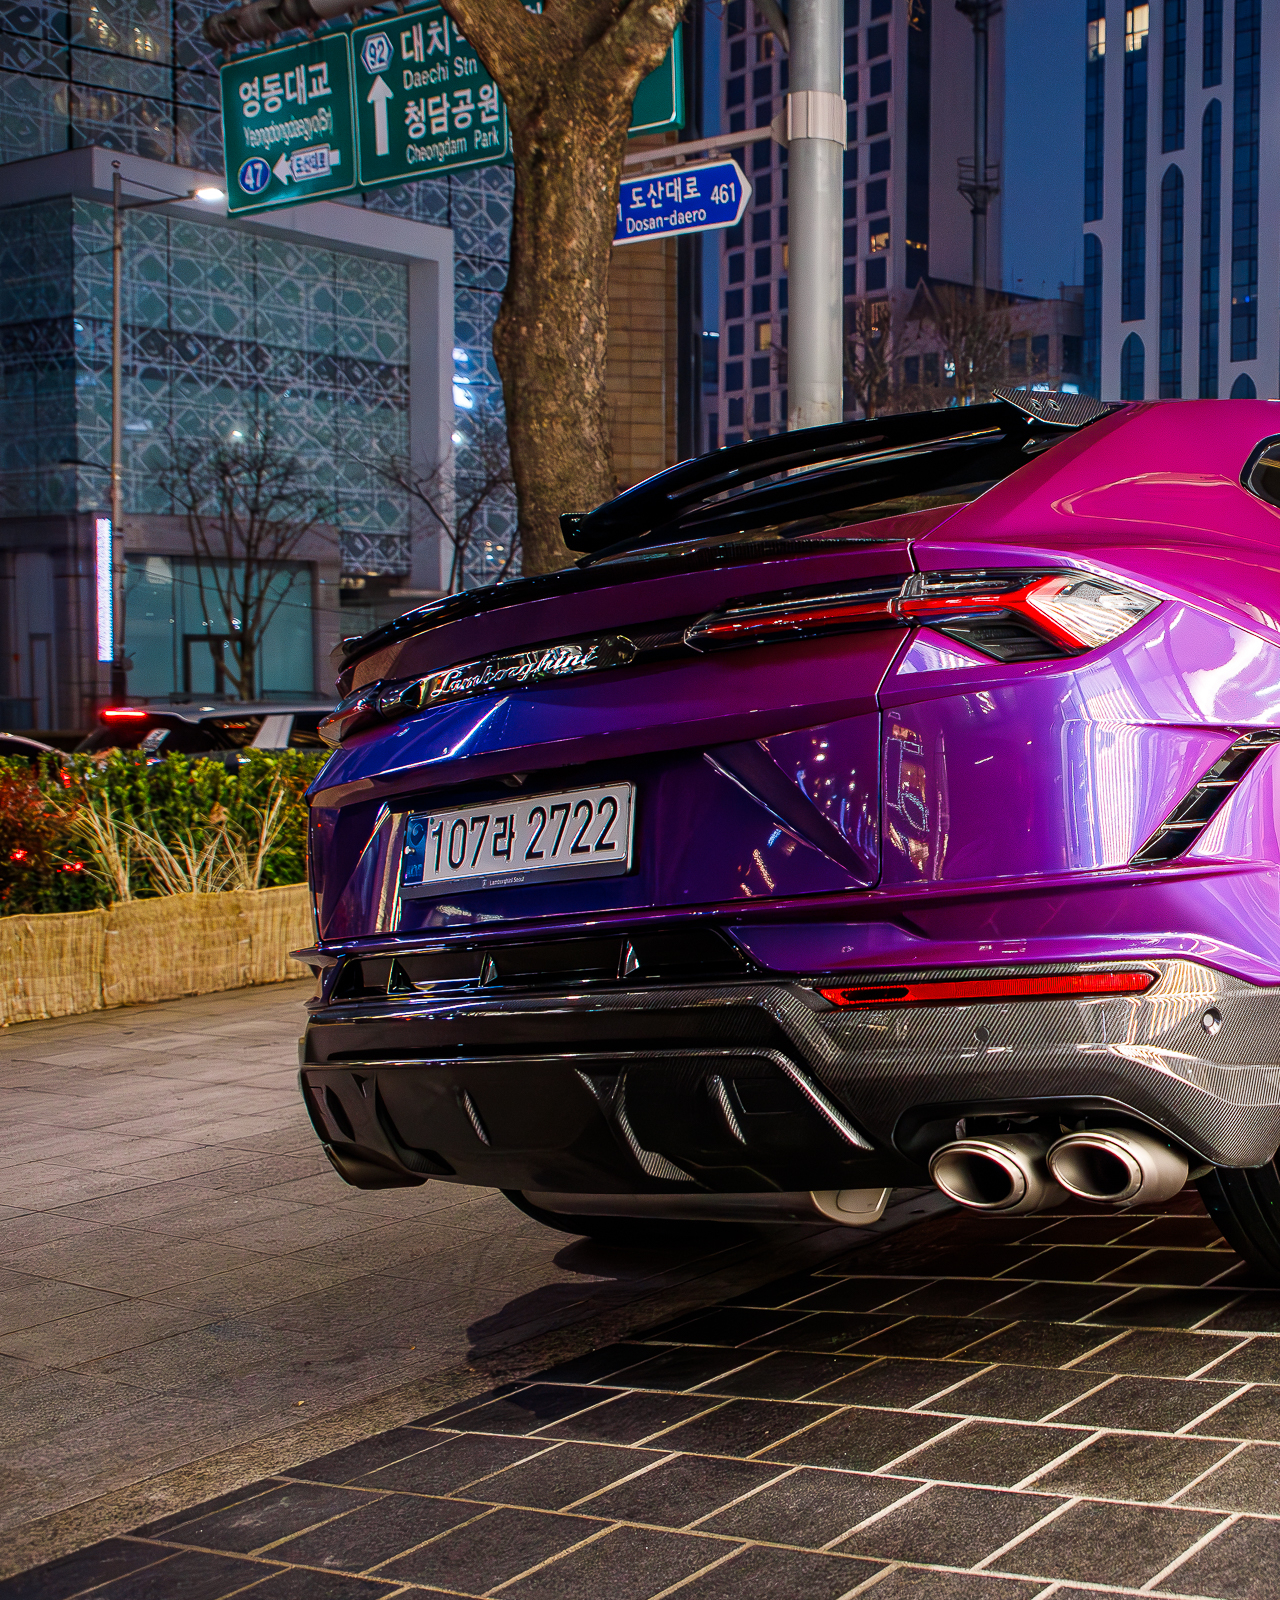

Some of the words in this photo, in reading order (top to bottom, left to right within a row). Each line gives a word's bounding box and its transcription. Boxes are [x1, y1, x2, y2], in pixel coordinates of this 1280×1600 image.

[368, 40, 385, 66] 92
[238, 61, 333, 118] 영동대교
[402, 60, 450, 91] Daechi
[453, 56, 479, 78] Stn
[404, 81, 500, 139] 청담공원
[405, 136, 468, 165] Cheongdam
[473, 125, 501, 150] Park
[244, 162, 263, 190] 47
[629, 177, 701, 209] 도산대로
[710, 182, 736, 205] 461
[626, 208, 707, 234] Dosan-daero
[430, 645, 599, 697] Lamborghini
[431, 814, 516, 874] 107라
[524, 796, 618, 862] 2722
